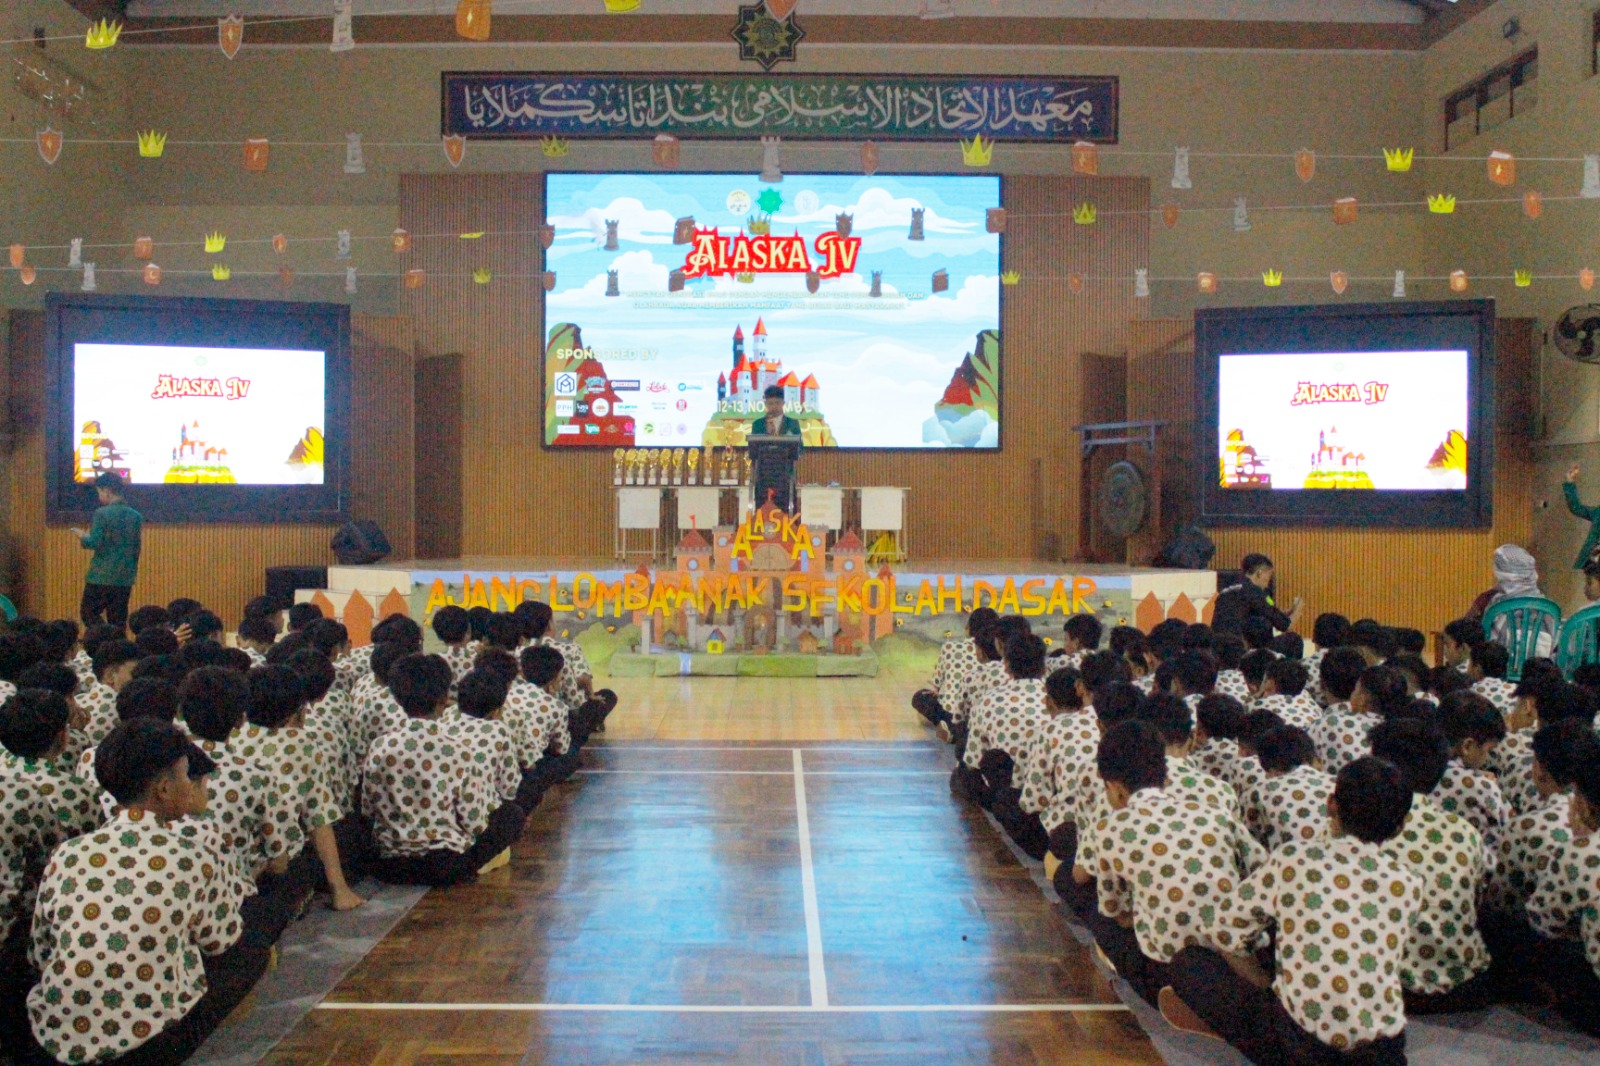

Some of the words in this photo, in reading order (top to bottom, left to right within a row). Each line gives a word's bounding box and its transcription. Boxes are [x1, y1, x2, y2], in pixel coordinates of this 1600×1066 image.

[680, 229, 809, 278] ALASKA
[556, 348, 637, 360] SPONSORED
[152, 375, 223, 399] ALASKA
[1291, 382, 1361, 405] ALASKA
[731, 508, 815, 560] ALASKA
[425, 574, 541, 614] AJANG
[549, 572, 671, 618] LOMBA
[674, 573, 771, 615] ANAK
[973, 576, 1098, 616] DASAR
